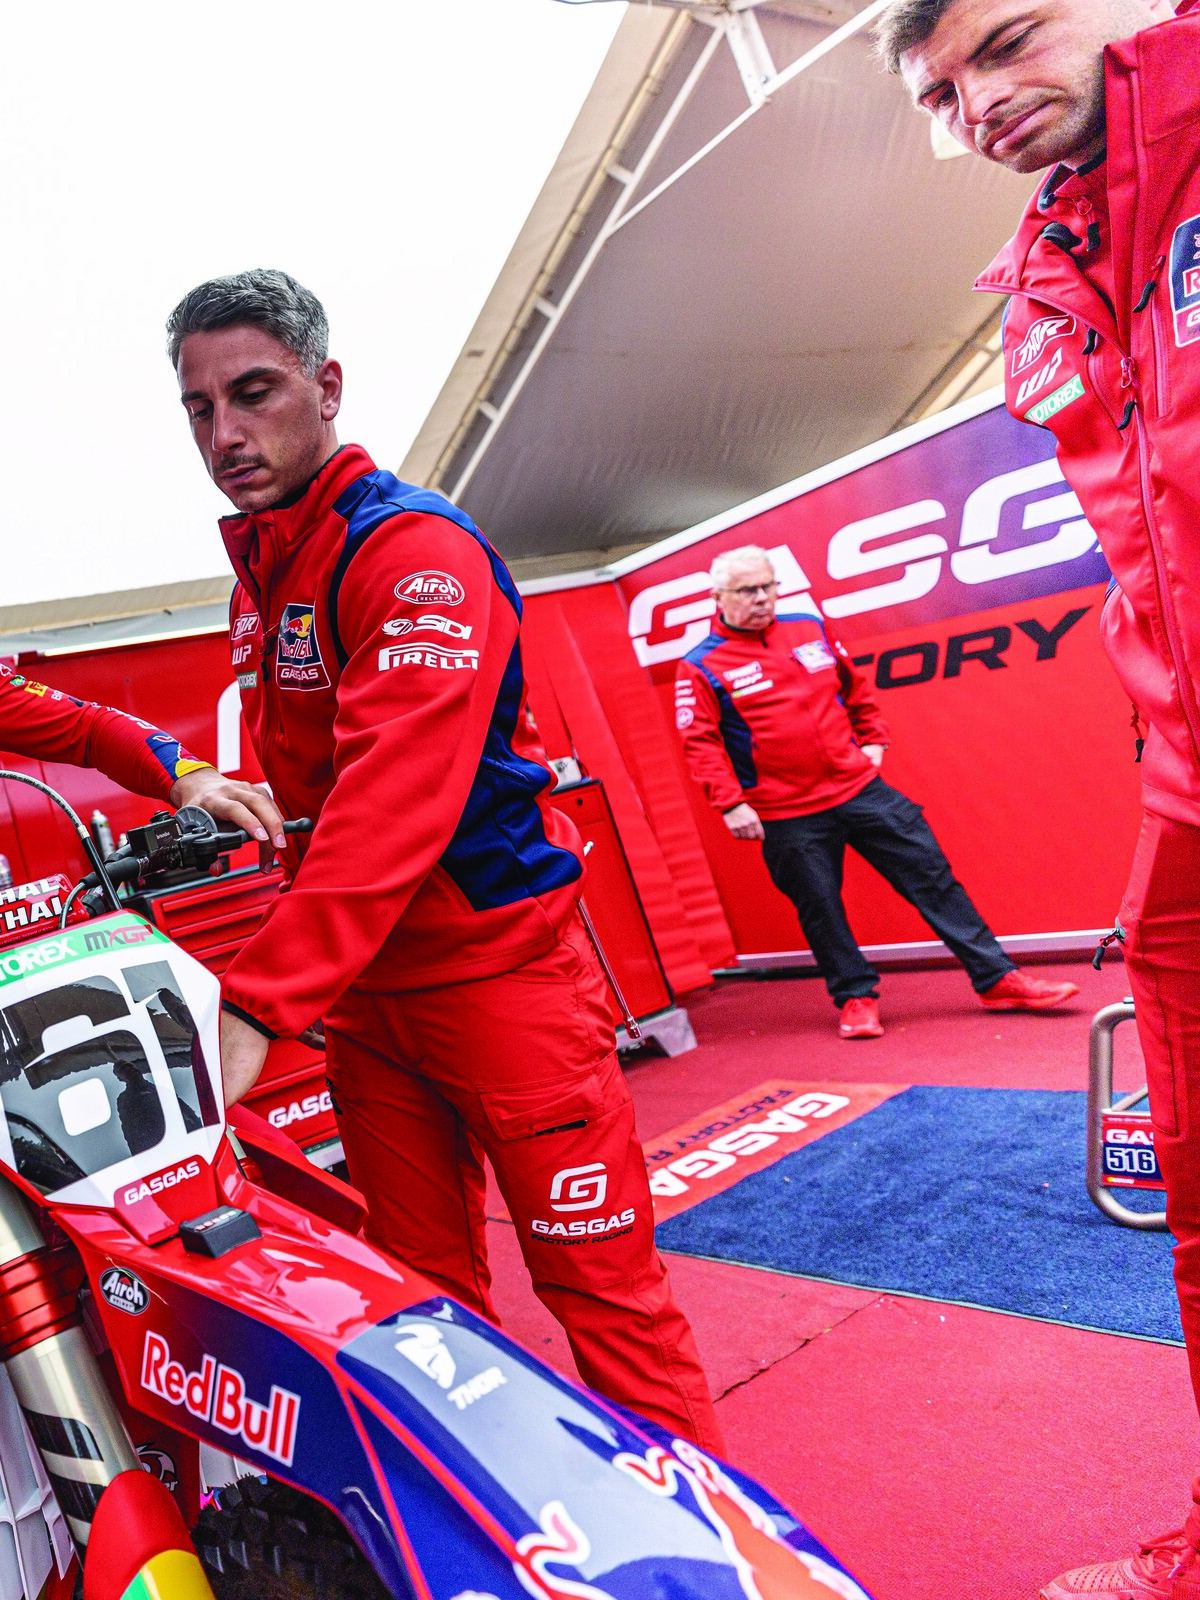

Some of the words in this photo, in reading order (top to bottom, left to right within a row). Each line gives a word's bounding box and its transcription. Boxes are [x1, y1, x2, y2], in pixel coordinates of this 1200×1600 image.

[402, 577, 459, 599] Airoh
[378, 641, 480, 672] PIRELLI
[83, 923, 155, 952] MXGP
[268, 1090, 334, 1129] GASG
[123, 1160, 202, 1206] GASGAS
[530, 1232, 589, 1246] FACTORY
[591, 1225, 634, 1244] RACING
[531, 1207, 636, 1237] GASGAS
[103, 1272, 144, 1306] Airoh
[140, 1329, 217, 1422] Red
[211, 1362, 302, 1468] Bull
